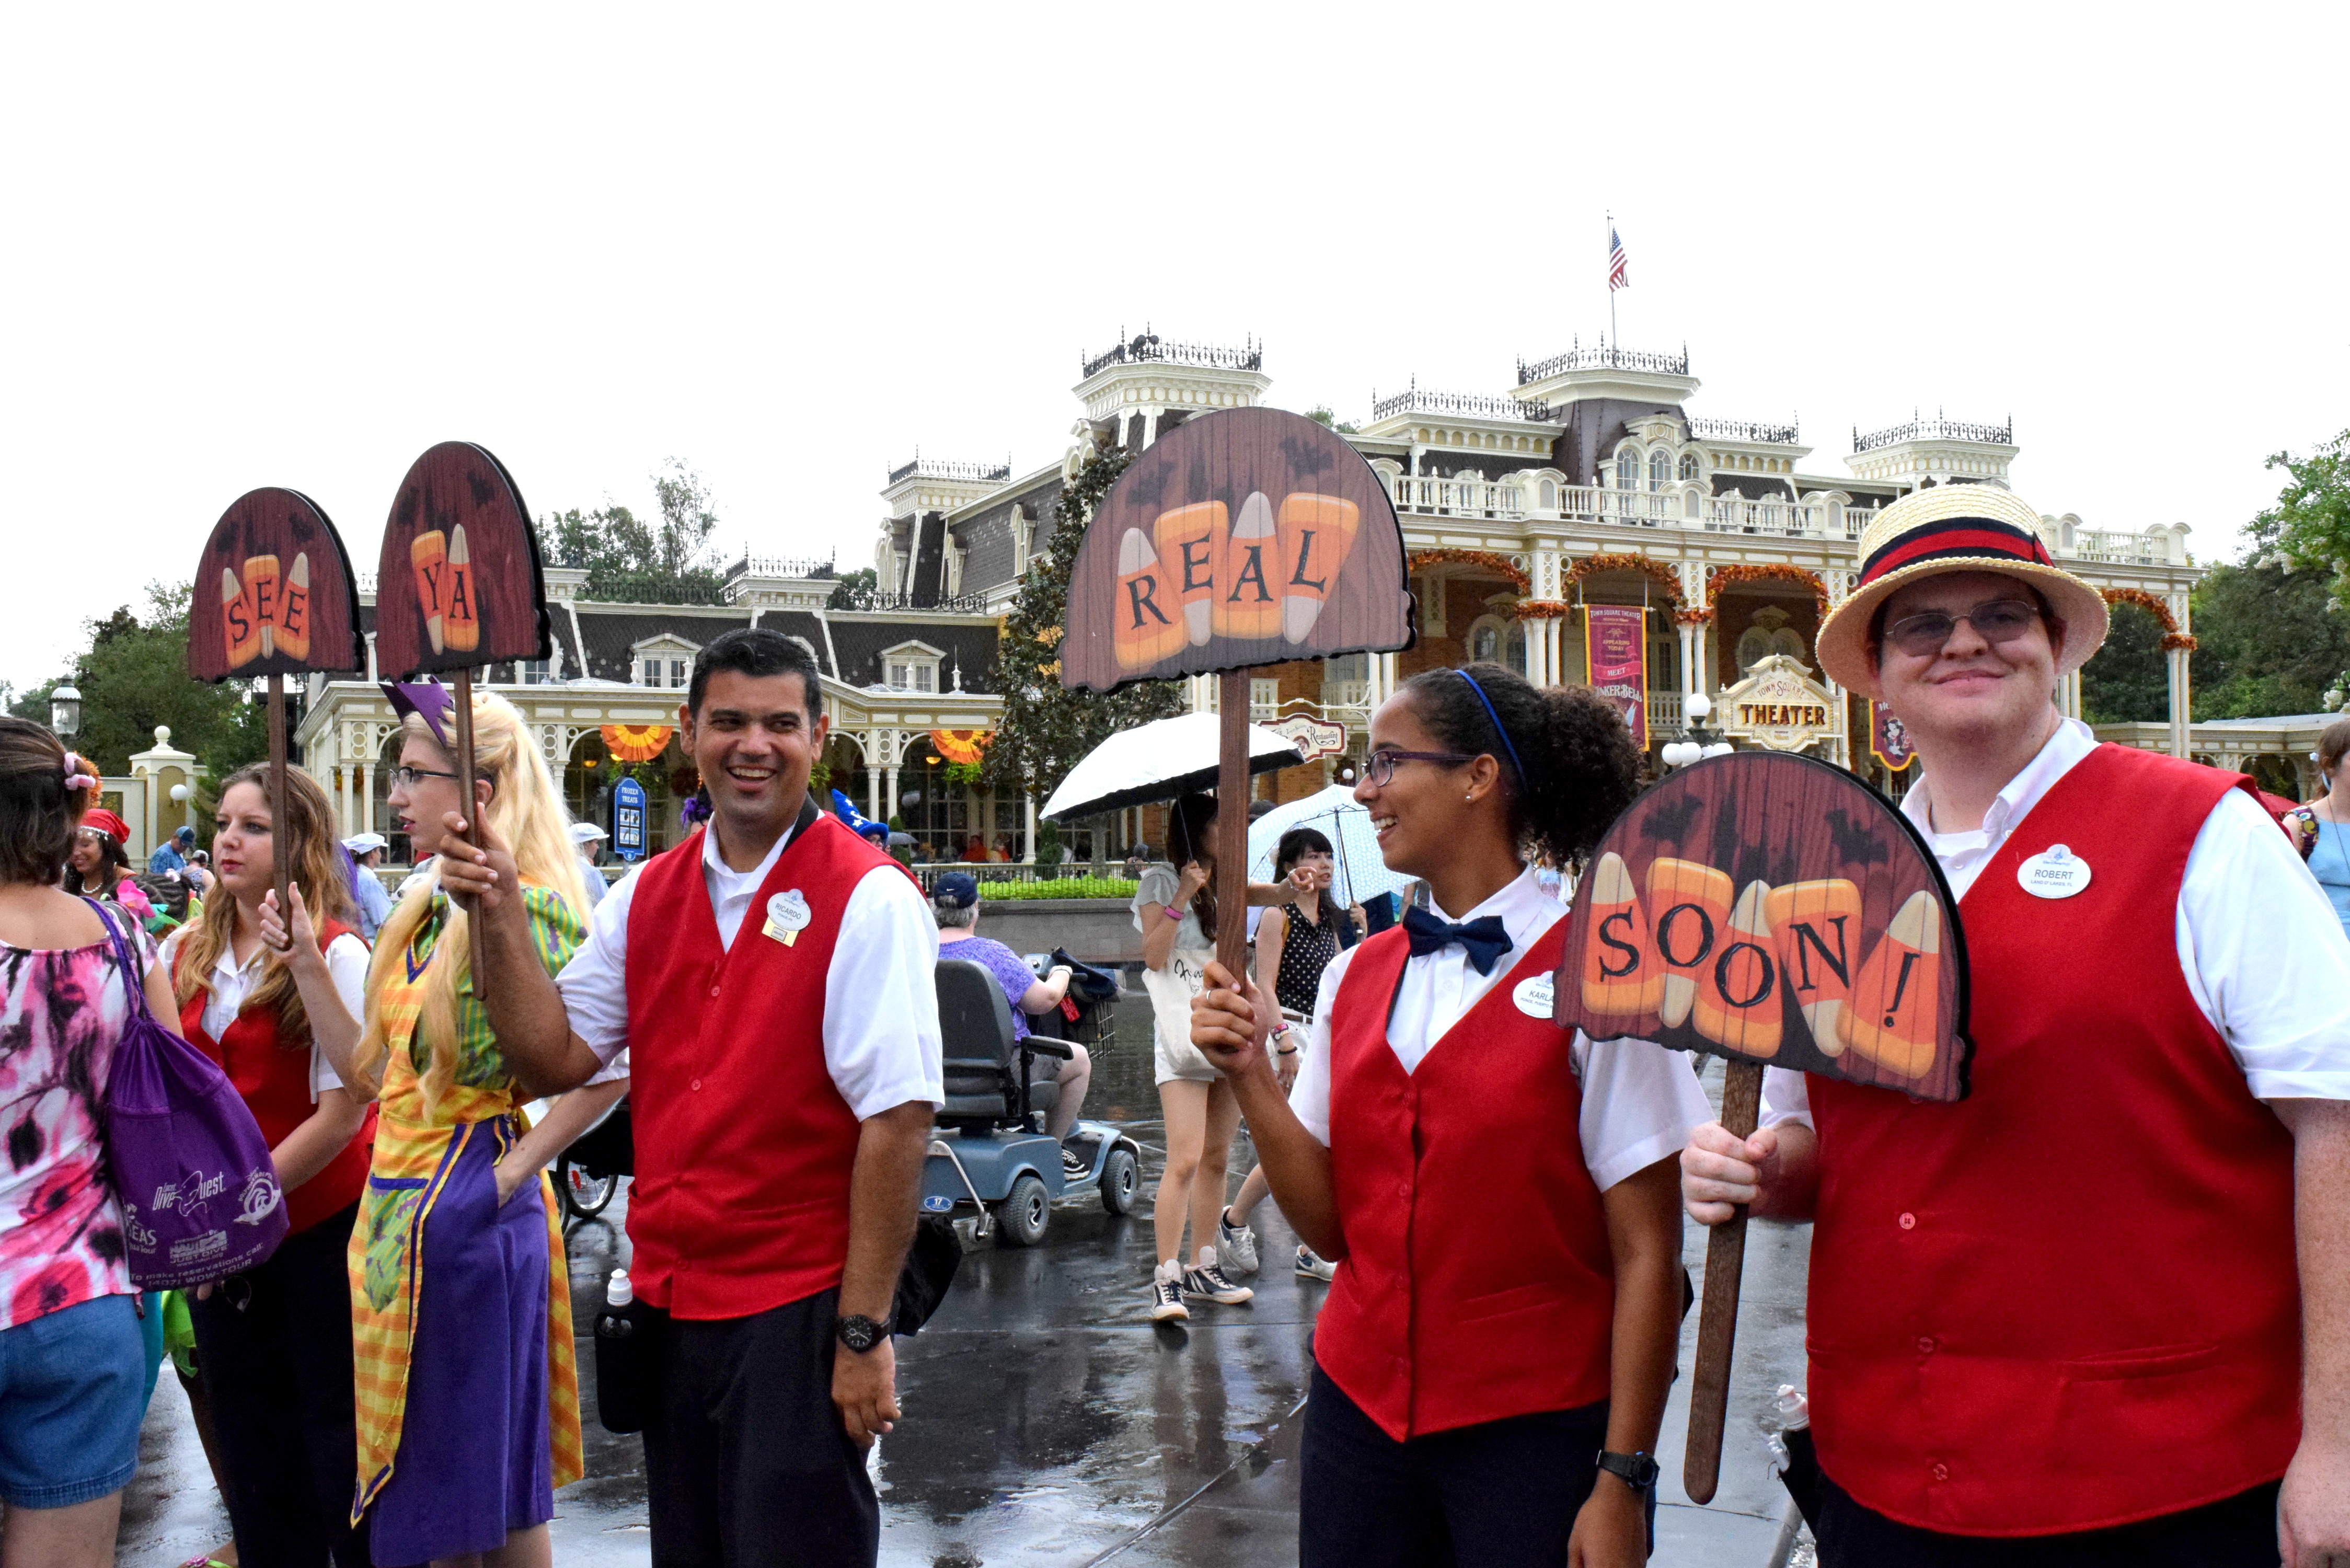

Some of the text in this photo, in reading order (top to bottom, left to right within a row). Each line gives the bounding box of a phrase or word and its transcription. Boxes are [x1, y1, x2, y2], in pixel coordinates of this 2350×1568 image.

[422, 560, 472, 620] YA
[1126, 529, 1326, 631] REAL
[228, 578, 306, 649] SEE
[1590, 609, 1603, 618] TOWN
[1621, 610, 1641, 621] THEATER
[1607, 667, 1626, 676] MEET
[1620, 684, 1642, 702] BELL
[1757, 681, 1805, 699] TOWN SQUARE
[1738, 704, 1825, 726] THEATER
[1307, 725, 1338, 746] Restaurant
[621, 787, 639, 795] FROZEN
[622, 795, 638, 804] TREATS
[2034, 869, 2073, 880] ROBERT
[775, 903, 801, 919] RICARDO
[1598, 903, 1920, 1029] SOON!
[129, 1224, 157, 1246] EAS
[170, 1253, 199, 1264] JUST
[202, 1244, 227, 1258] DIVE
[146, 1272, 174, 1280] make
[178, 1254, 244, 1277] reservations
[185, 1259, 252, 1283] WOW-TOUR
